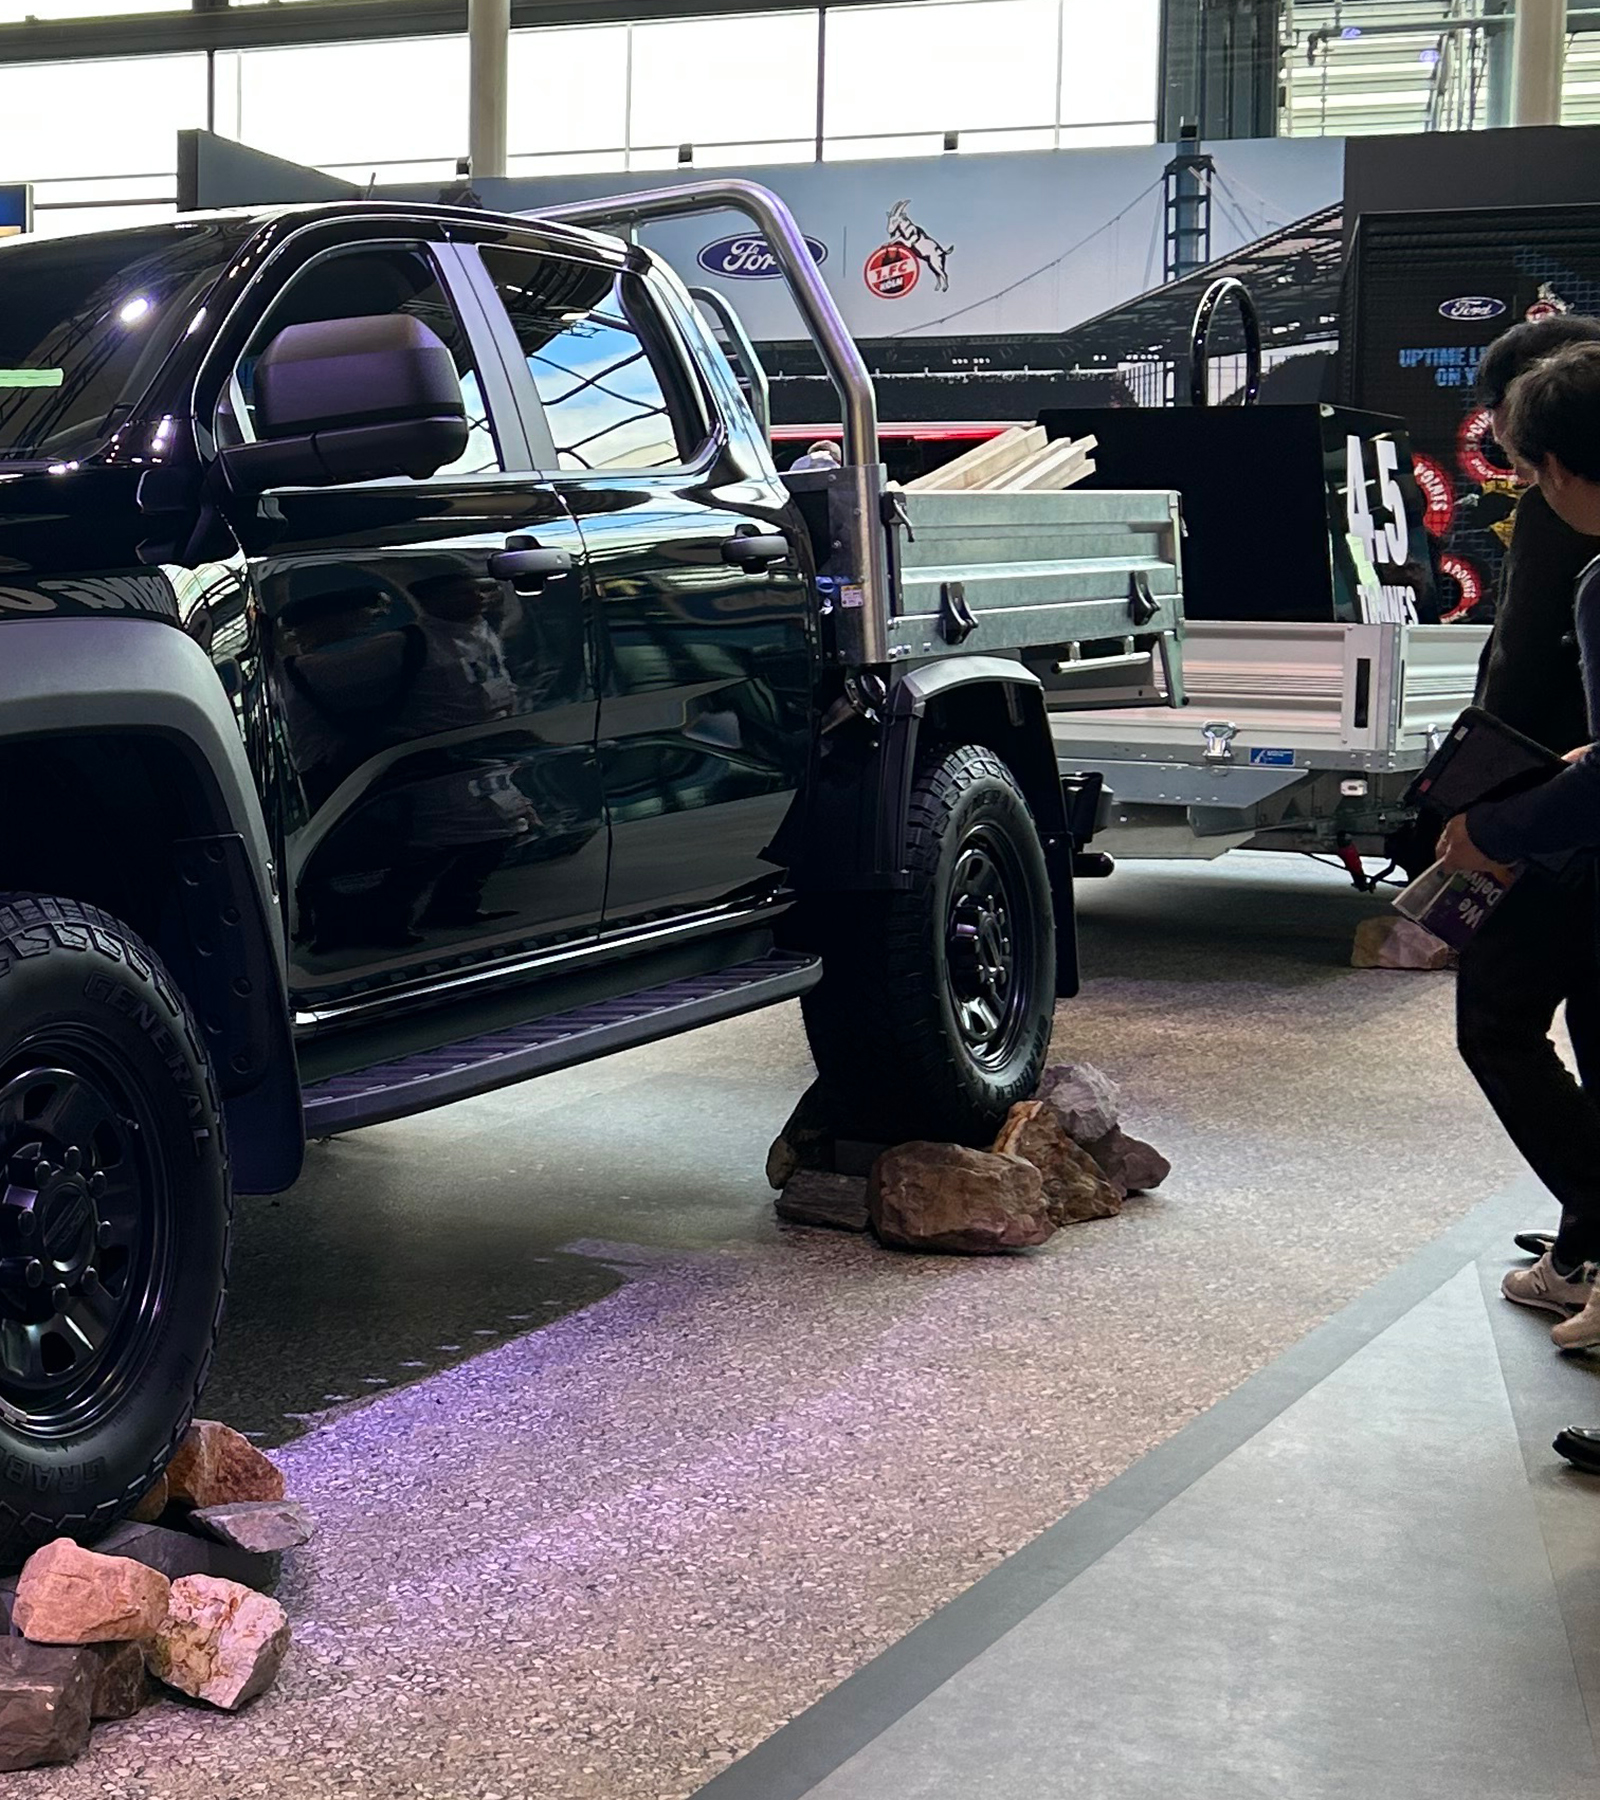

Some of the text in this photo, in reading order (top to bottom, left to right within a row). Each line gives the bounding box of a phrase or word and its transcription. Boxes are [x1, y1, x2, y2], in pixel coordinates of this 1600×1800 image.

[1451, 300, 1493, 316] Ford
[1399, 348, 1466, 368] UPTIME
[1346, 434, 1409, 566] 4.5
[83, 970, 211, 1158] GENERAL
